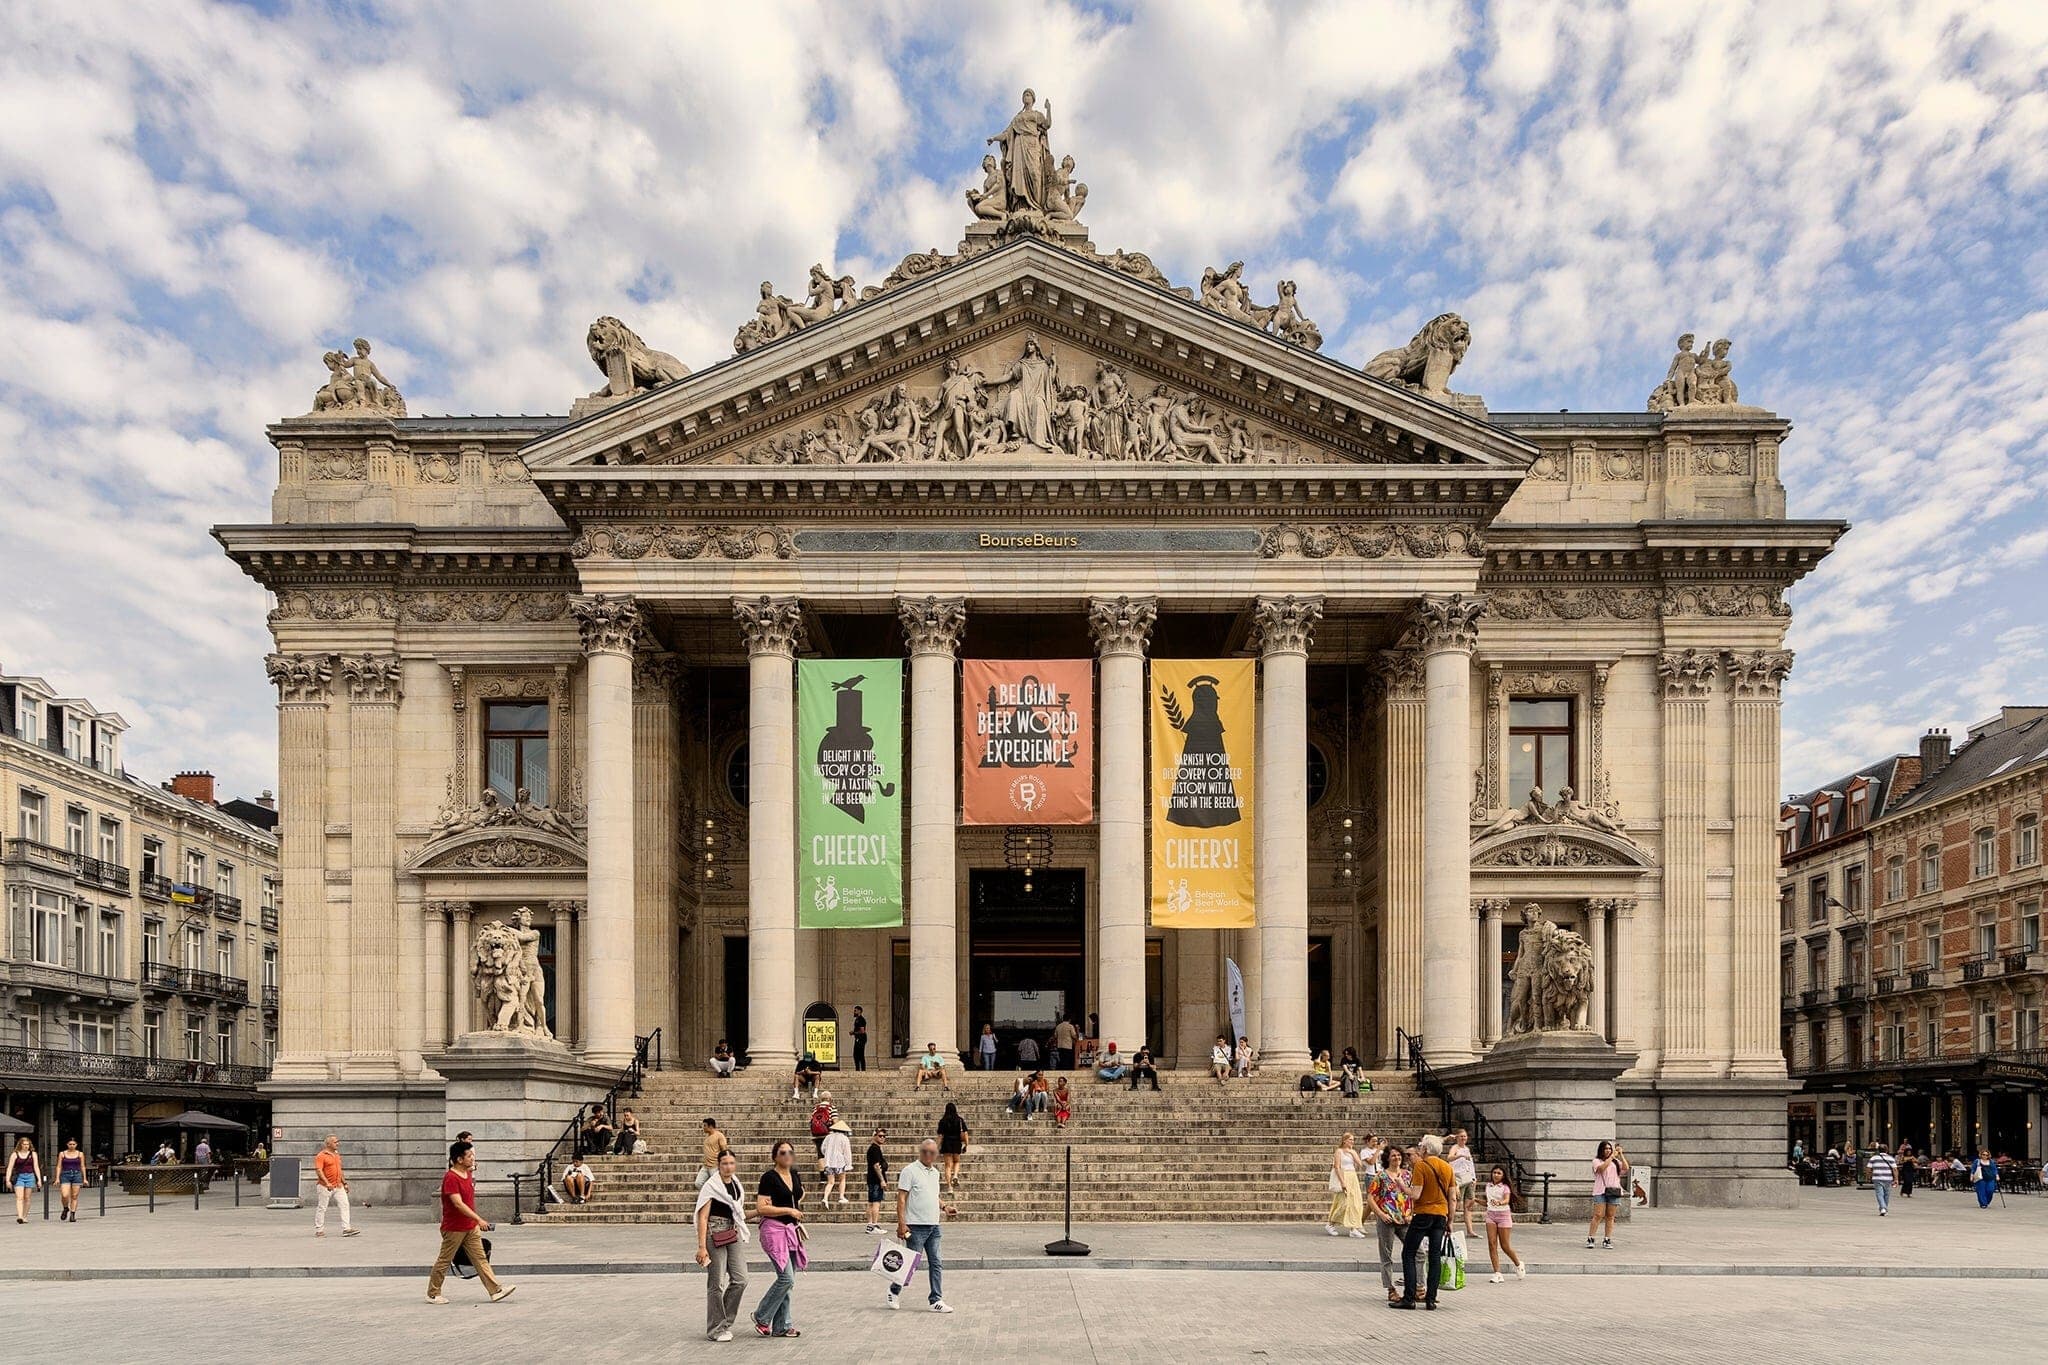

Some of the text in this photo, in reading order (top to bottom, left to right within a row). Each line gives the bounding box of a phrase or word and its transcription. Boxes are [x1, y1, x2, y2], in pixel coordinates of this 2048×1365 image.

[979, 533, 1078, 547] BourseBeurs
[977, 710, 1078, 735] BEER WORLD
[862, 749, 876, 762] THE
[1205, 753, 1231, 766] YOUR
[850, 763, 866, 776] OF
[867, 763, 885, 776] BEER
[1207, 767, 1223, 780] OF
[1224, 767, 1242, 780] BEER
[841, 777, 847, 790] A
[1228, 781, 1233, 794] A
[832, 791, 845, 804] THE
[1199, 796, 1213, 809] THE
[812, 834, 886, 866] CHEERS!
[1166, 838, 1239, 869] CHEERS!
[842, 887, 874, 897] Belgian
[1195, 890, 1226, 899] Belgian
[842, 896, 887, 904] Beer World
[1195, 898, 1239, 906] Beer World
